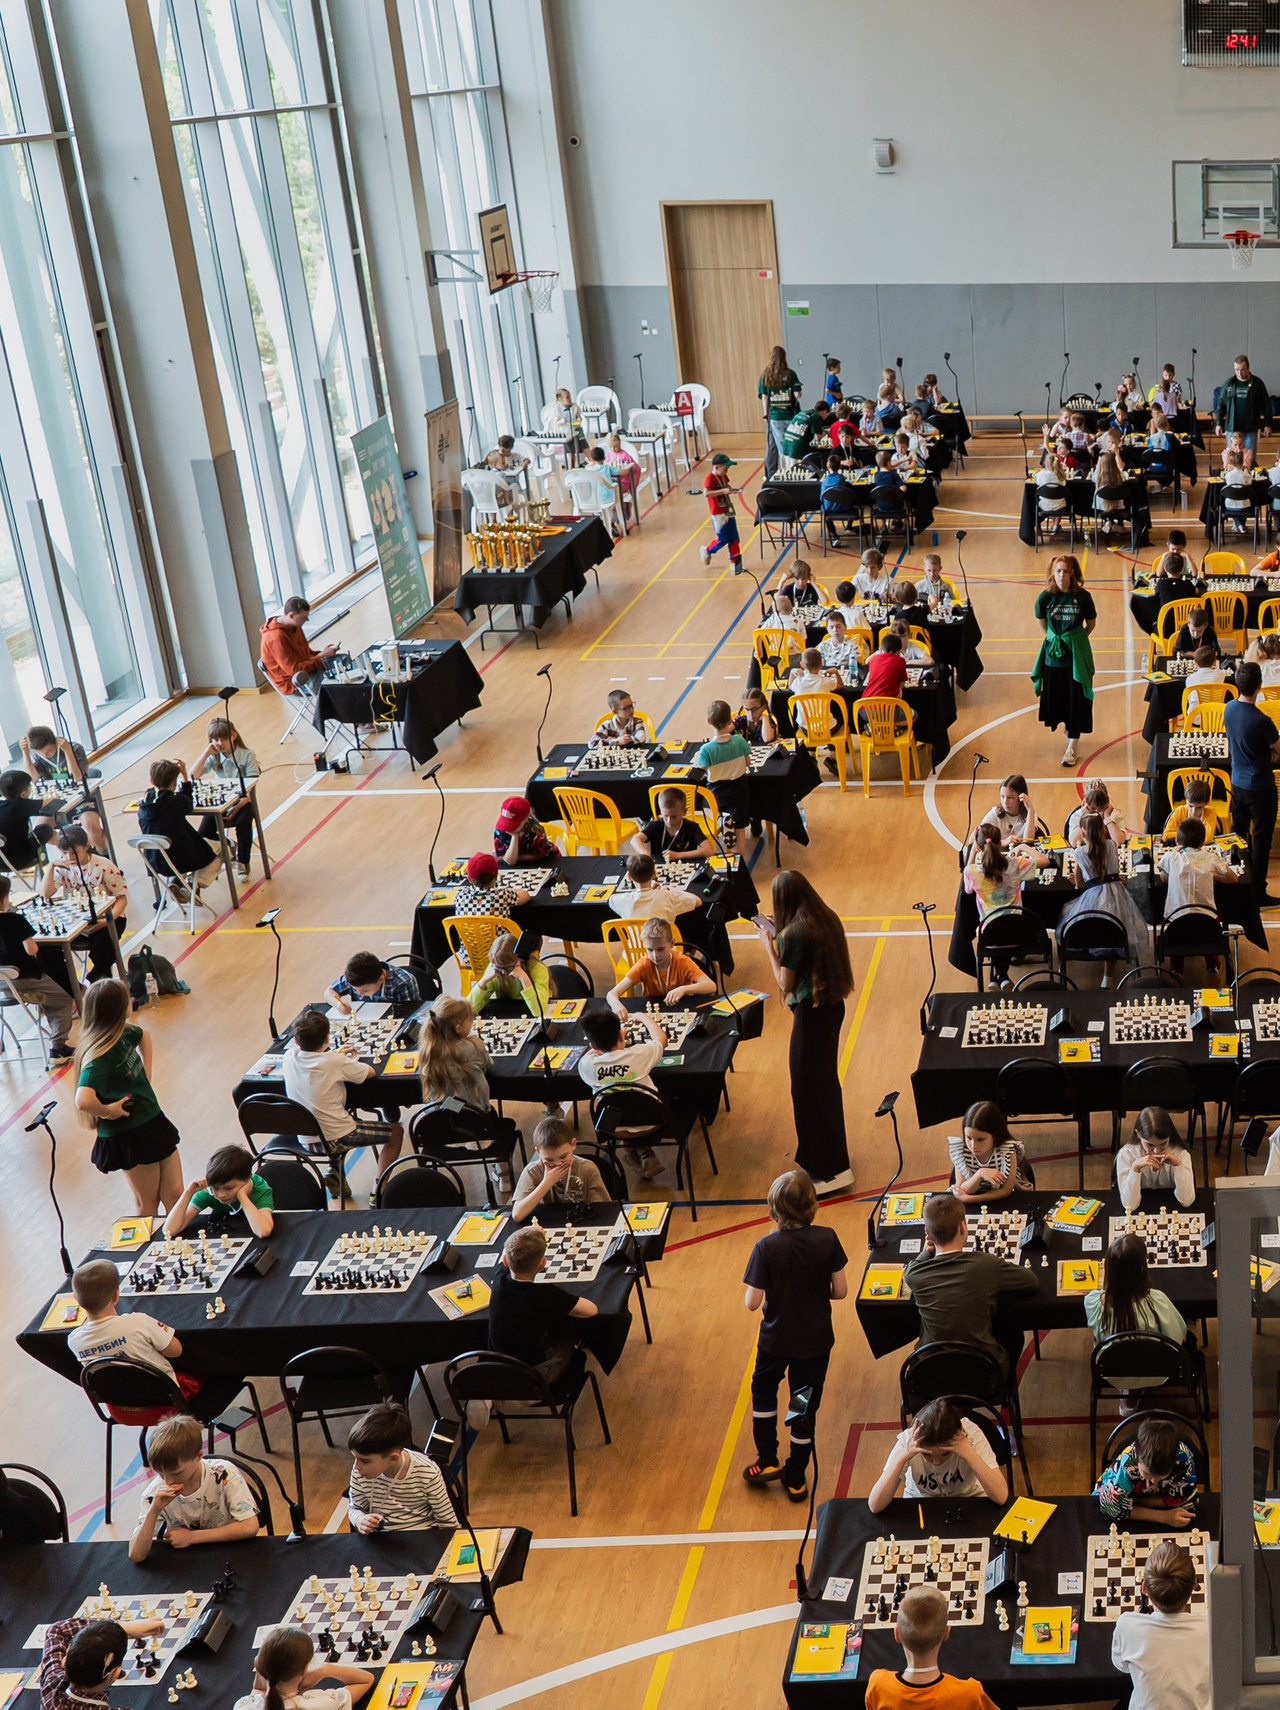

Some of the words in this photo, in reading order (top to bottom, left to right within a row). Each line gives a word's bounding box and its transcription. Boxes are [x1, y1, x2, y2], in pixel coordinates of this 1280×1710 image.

[678, 392, 692, 408] A
[597, 1065, 630, 1080] SURF
[78, 1336, 127, 1359] ДЕРЯБИН
[833, 1582, 846, 1598] 12
[1066, 1579, 1079, 1591] 11
